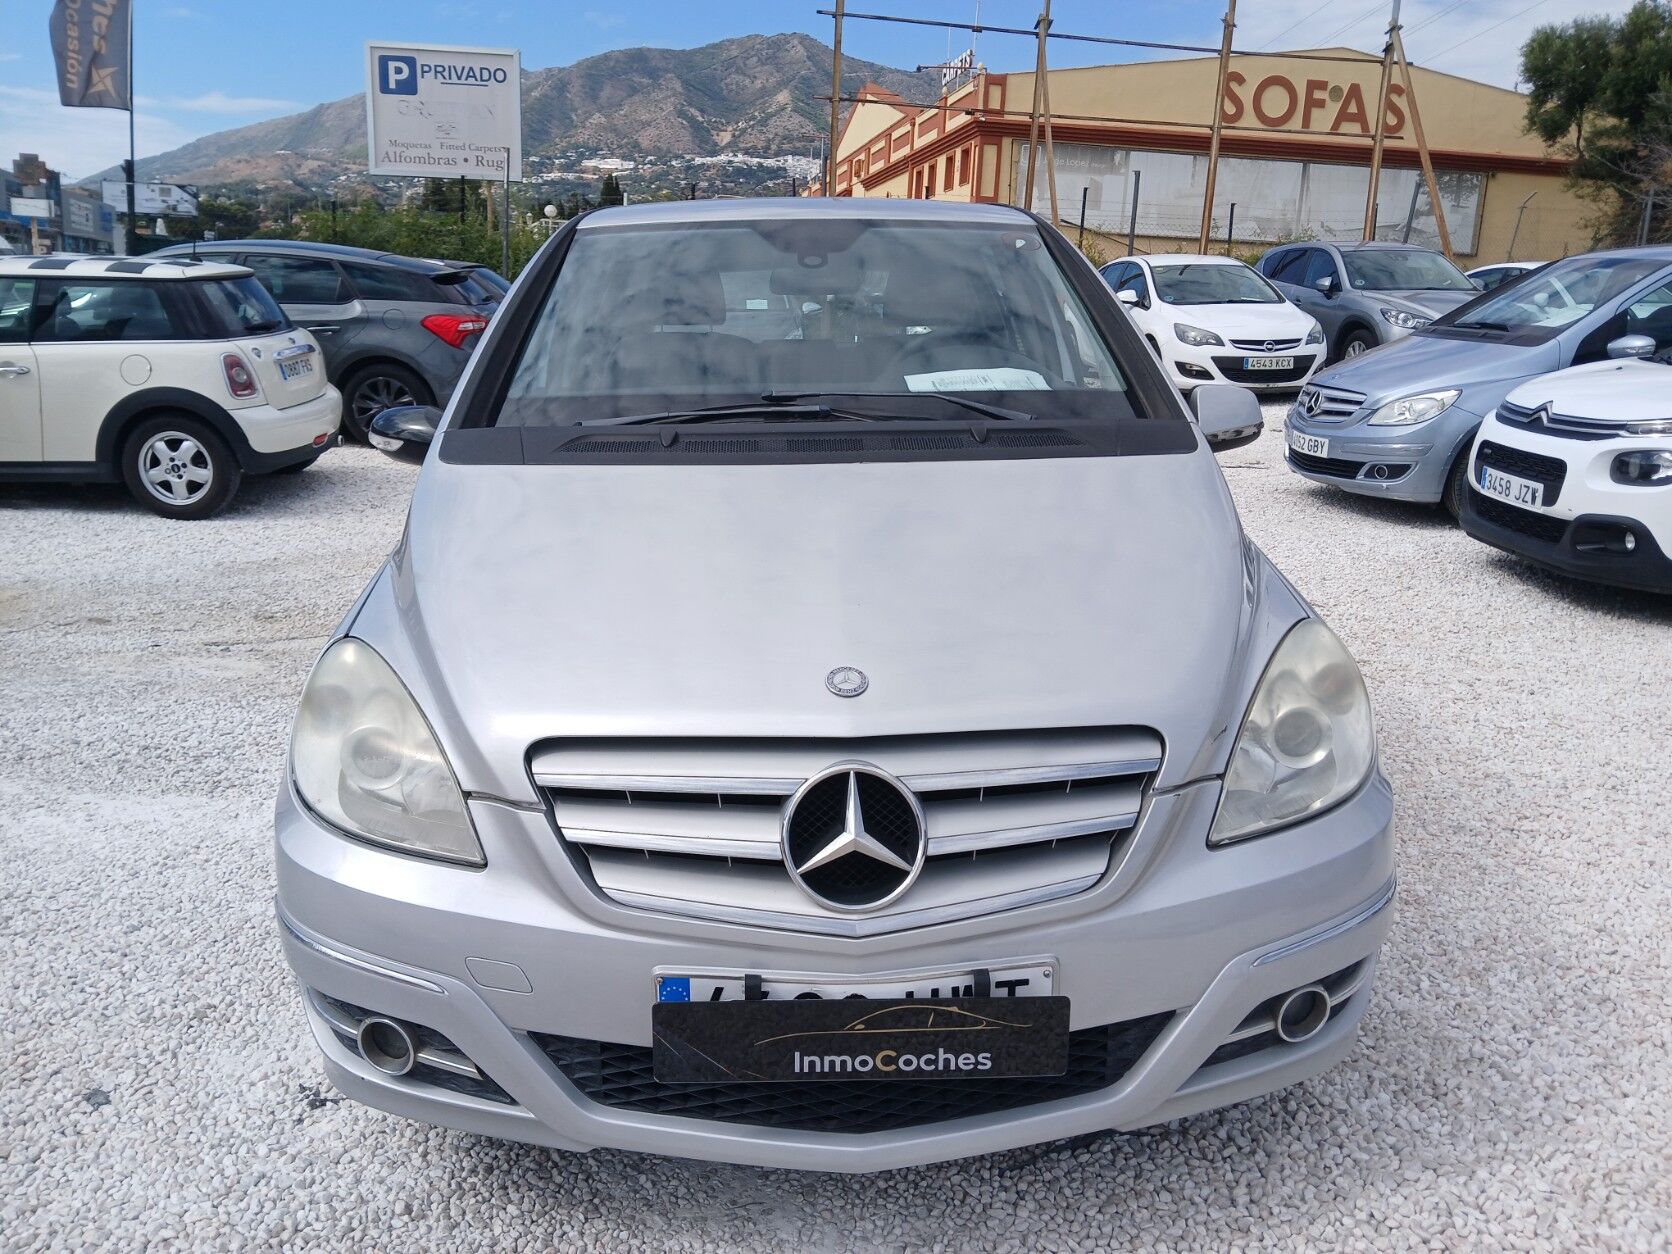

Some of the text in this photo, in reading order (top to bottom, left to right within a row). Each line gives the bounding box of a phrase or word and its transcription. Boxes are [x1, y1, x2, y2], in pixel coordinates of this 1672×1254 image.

[387, 60, 507, 89] P PRIVADO
[1221, 71, 1406, 135] SOFAS
[389, 139, 502, 153] Moquetas Fitted Carpets
[381, 151, 457, 167] Alfombras
[1250, 359, 1292, 369] 4543 KCX
[1307, 438, 1326, 455] GBY
[1487, 473, 1512, 498] 3458
[794, 1047, 992, 1073] InmoCoches
